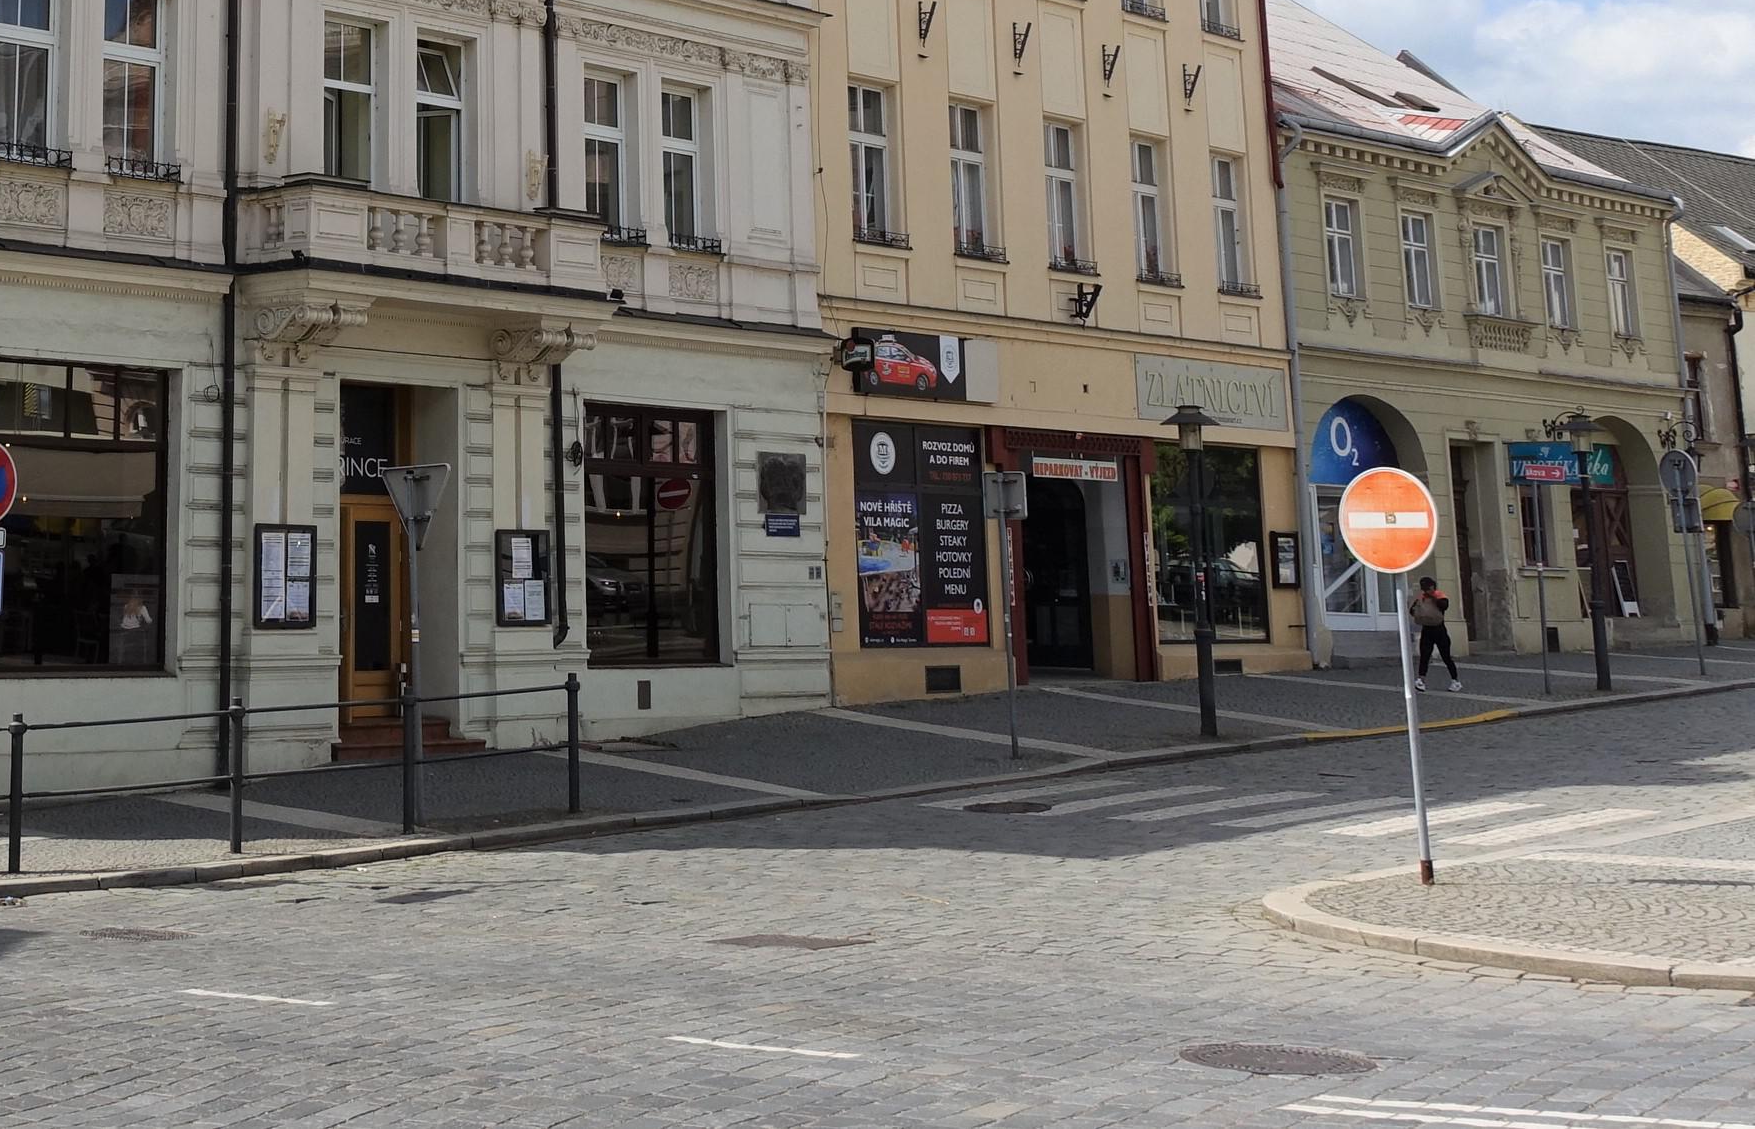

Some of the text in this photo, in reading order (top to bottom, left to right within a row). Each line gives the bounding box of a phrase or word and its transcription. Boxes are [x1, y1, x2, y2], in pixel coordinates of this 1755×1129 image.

[1145, 370, 1278, 419] ZLATNICTVÍ
[922, 441, 951, 452] ROZVOZ
[929, 455, 970, 466] A DO FIREM
[859, 500, 883, 512] NOVÉ
[941, 503, 964, 515] PIZZA
[863, 517, 910, 528] VILA MAGIC
[936, 519, 969, 531] BURGERY
[939, 535, 967, 546] STEAKY
[935, 552, 973, 563] HOTOVKY
[938, 566, 971, 579] POLEDNÍ
[944, 584, 967, 595] MENU
